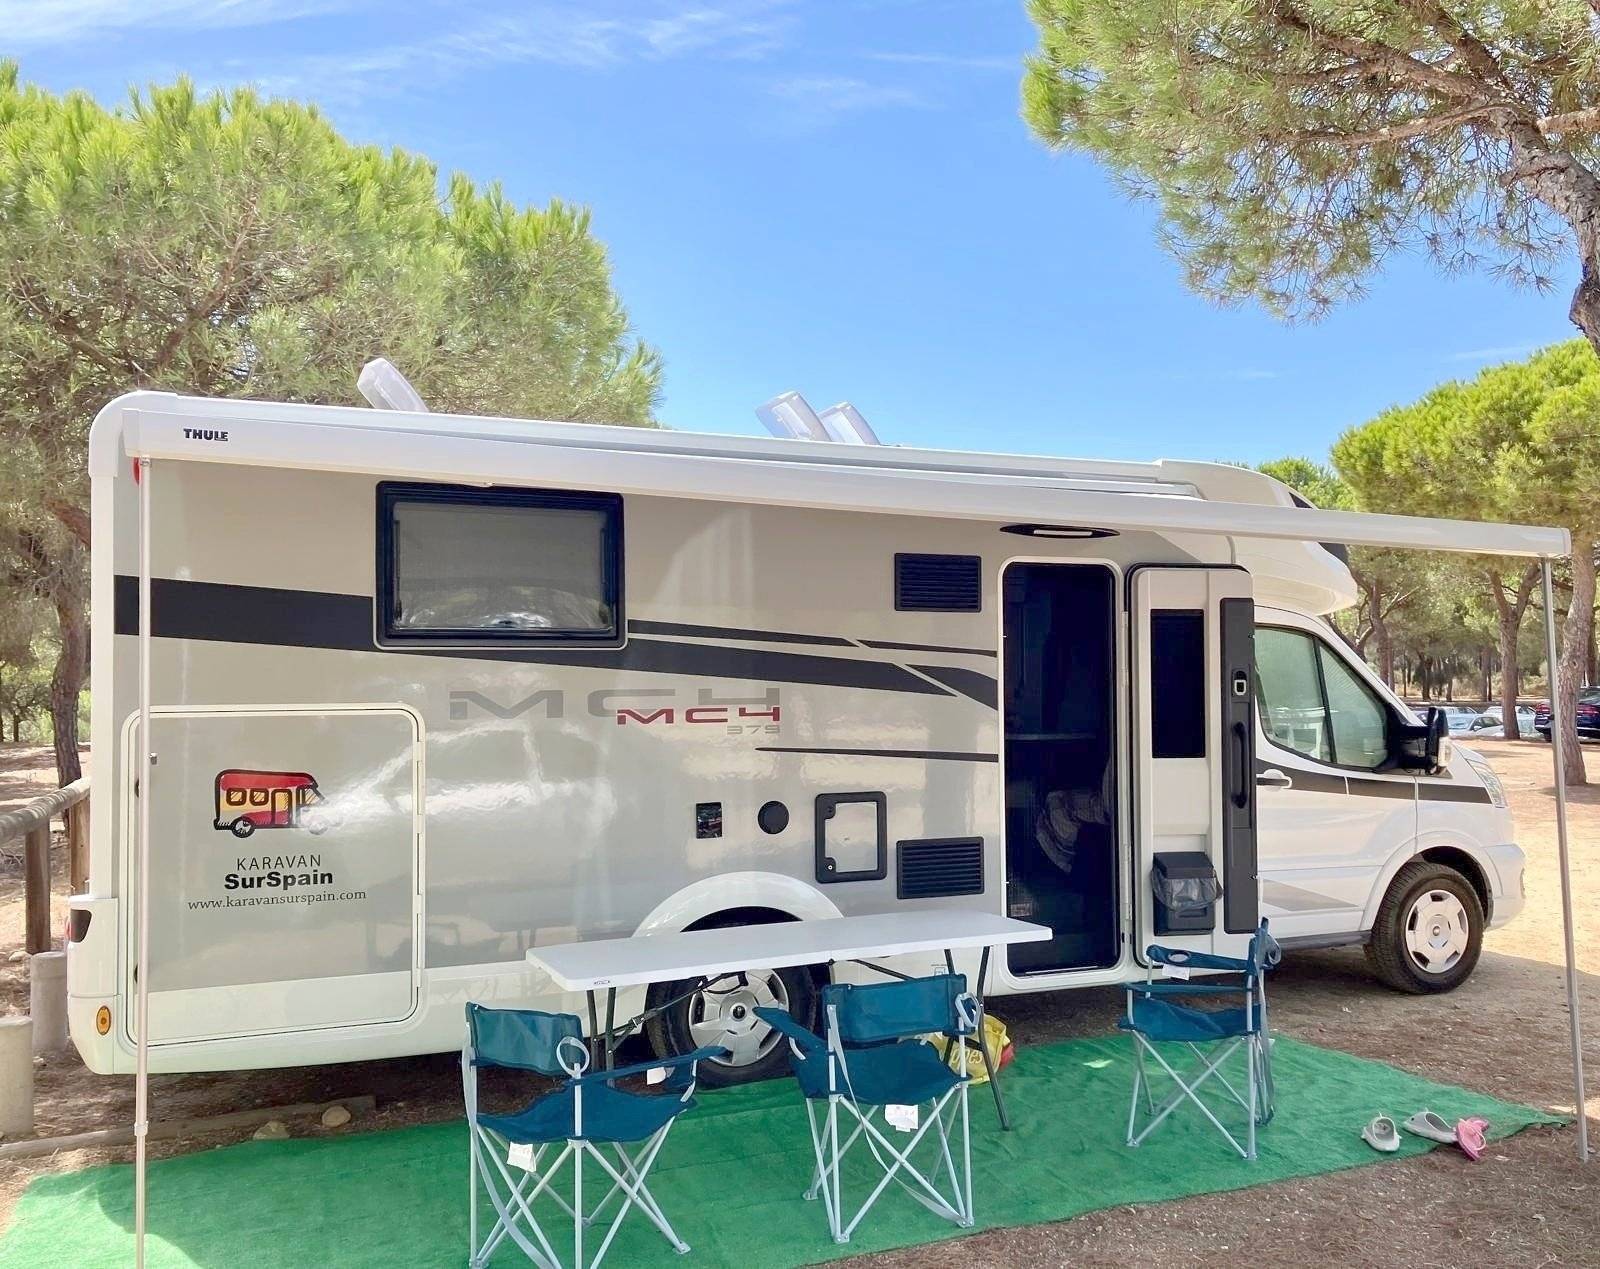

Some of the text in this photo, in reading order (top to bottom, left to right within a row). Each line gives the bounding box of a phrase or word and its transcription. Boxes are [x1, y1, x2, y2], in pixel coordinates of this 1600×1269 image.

[183, 428, 229, 441] THULE
[726, 724, 781, 735] 379
[236, 854, 322, 871] KARAVAN
[224, 869, 333, 890] SurSpain
[187, 890, 367, 910] www.karavansurspain.com
